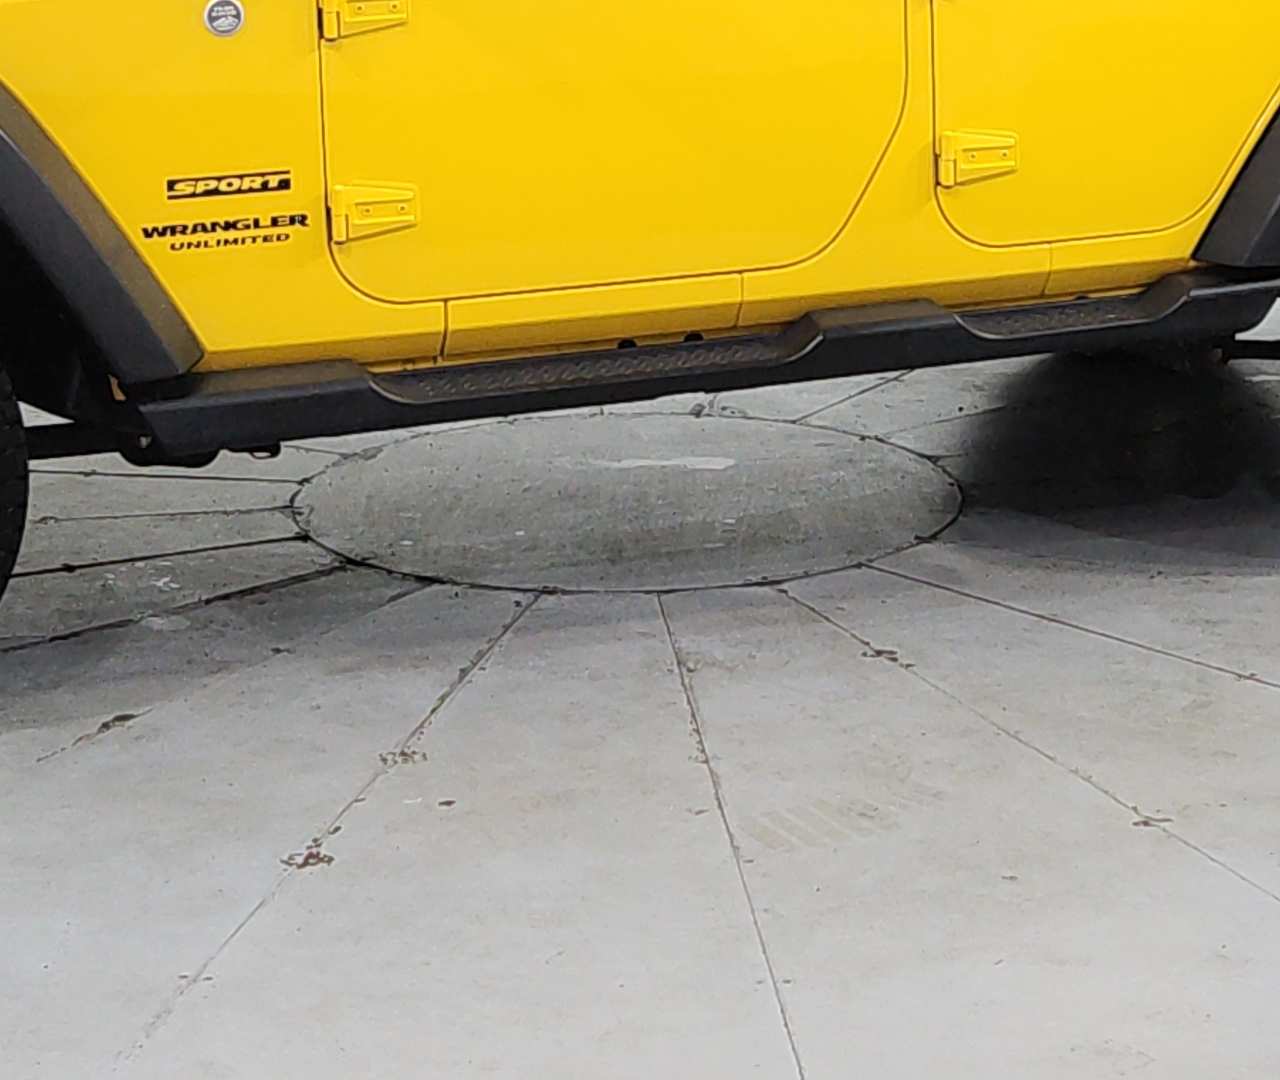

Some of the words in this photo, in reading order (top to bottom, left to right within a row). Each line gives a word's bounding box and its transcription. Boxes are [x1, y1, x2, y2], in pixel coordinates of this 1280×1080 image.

[171, 174, 286, 196] SPORT
[141, 213, 310, 239] WRANGLER
[169, 233, 290, 251] UNLIMITED
